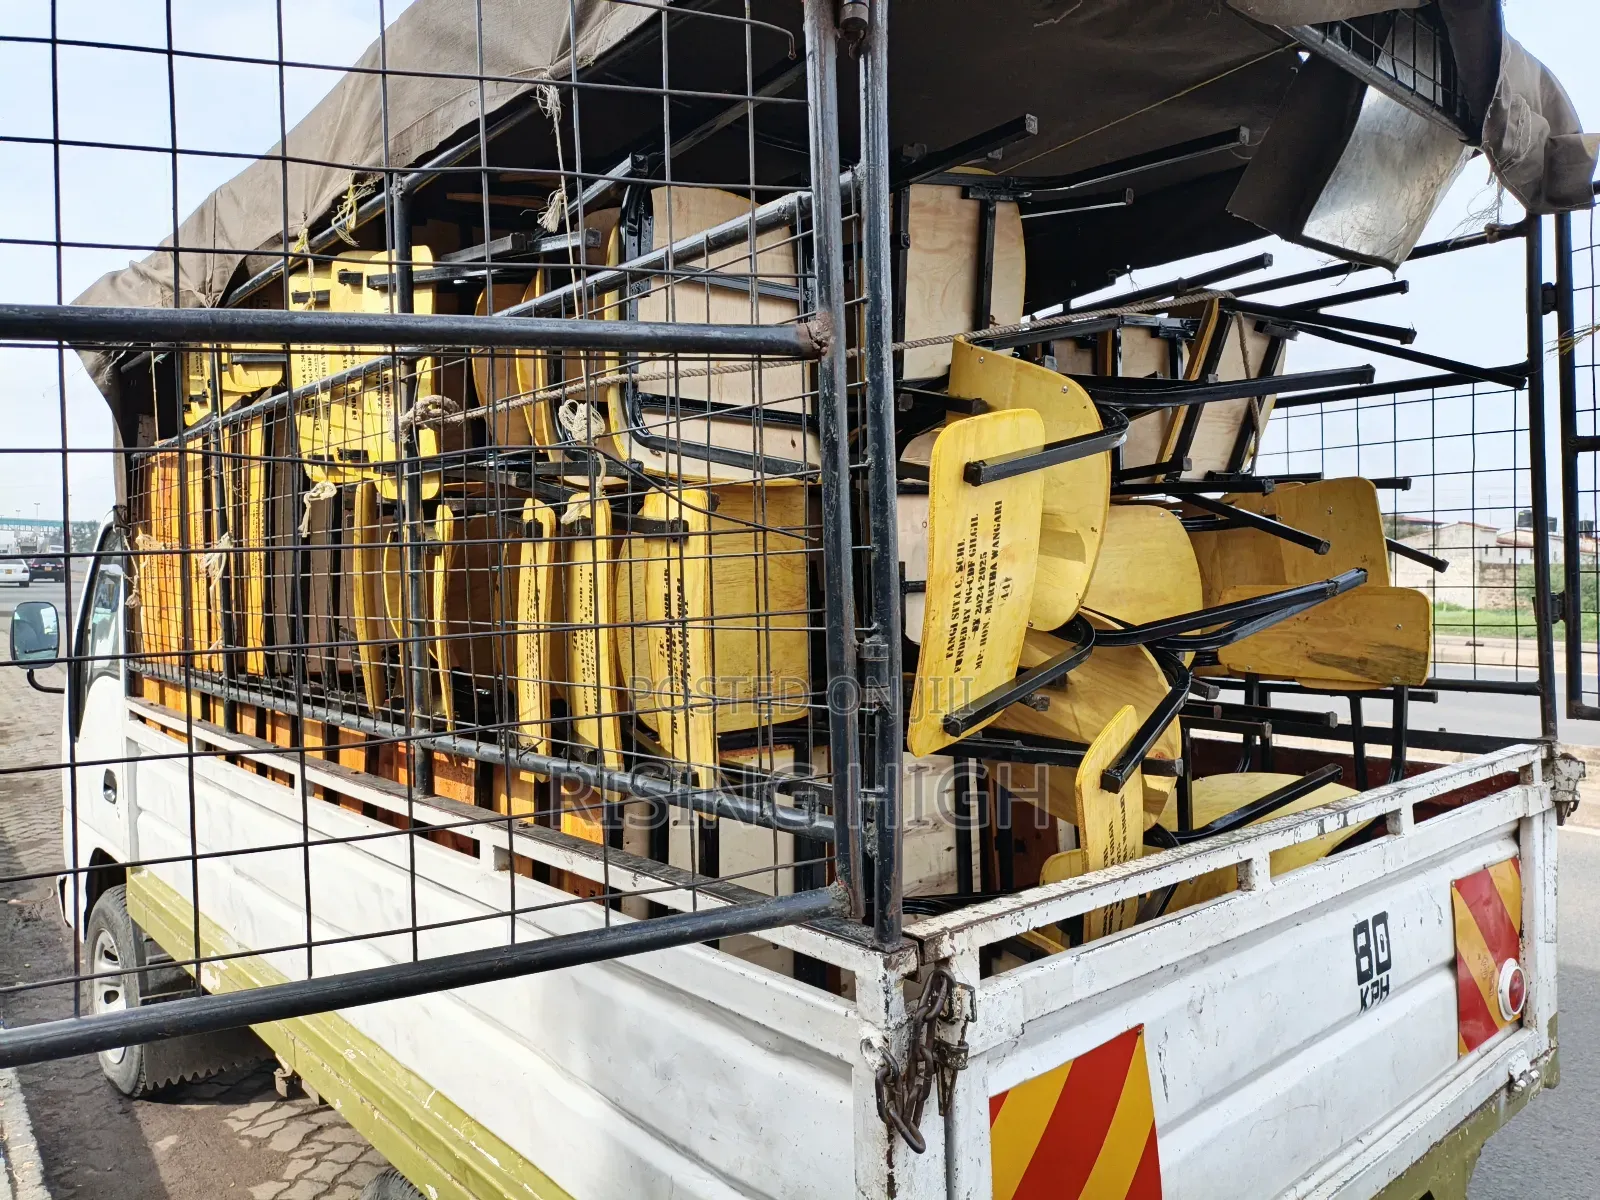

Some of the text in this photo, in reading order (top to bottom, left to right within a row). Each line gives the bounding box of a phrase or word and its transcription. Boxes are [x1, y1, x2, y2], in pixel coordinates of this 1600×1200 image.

[953, 513, 979, 673] FUNDED BY NG-CDF GILGIL
[974, 551, 988, 615] 2024-2025
[974, 500, 1003, 670] MP: HON. MARTHA WANGARI
[1353, 911, 1392, 986] 80
[1358, 974, 1390, 1012] KPH
